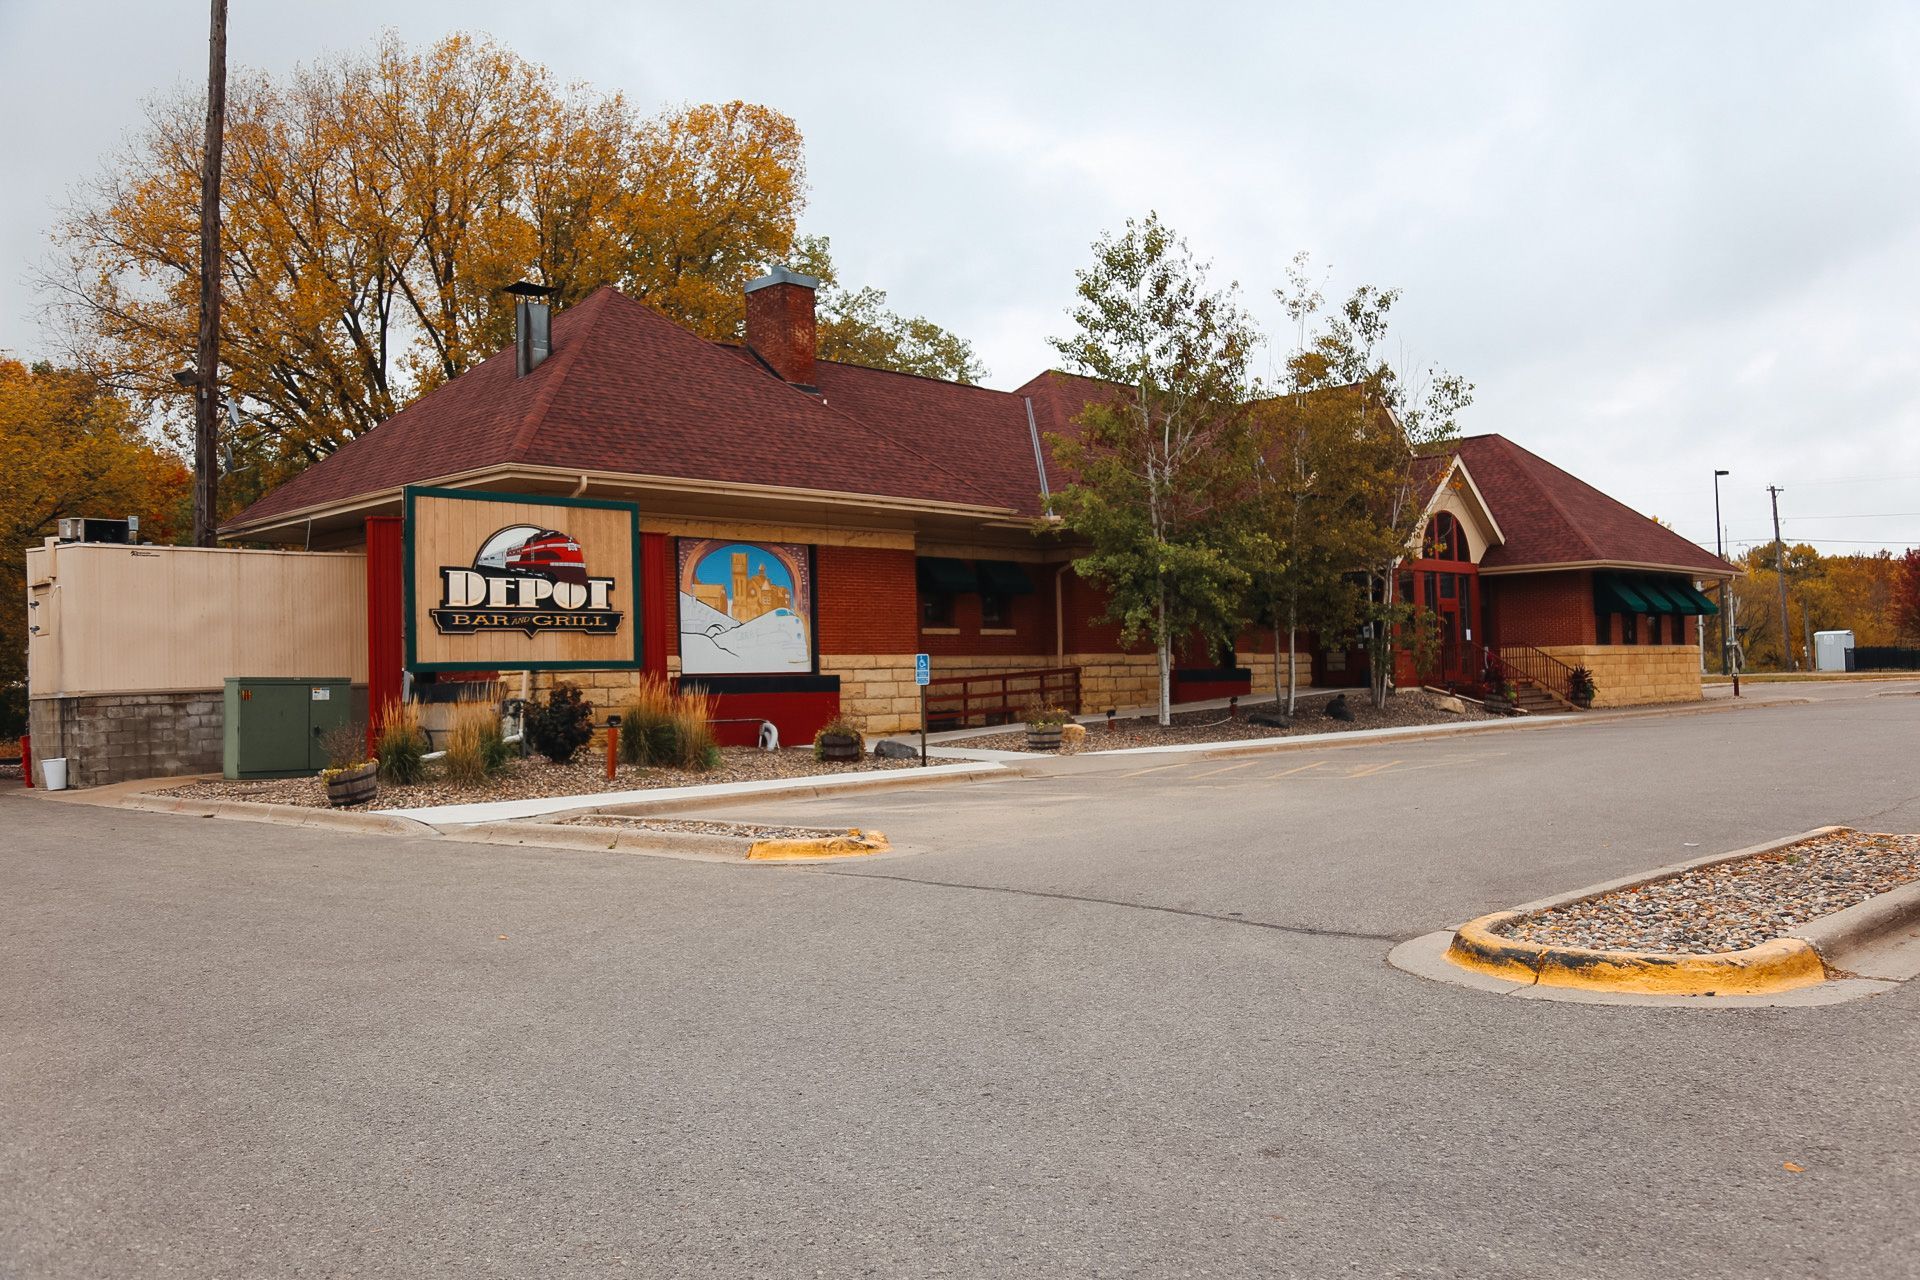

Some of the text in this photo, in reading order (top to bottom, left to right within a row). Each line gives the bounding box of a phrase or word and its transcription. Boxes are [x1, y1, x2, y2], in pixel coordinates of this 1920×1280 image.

[445, 570, 612, 610] DEPOT
[452, 614, 608, 626] BAR AND GRILL
